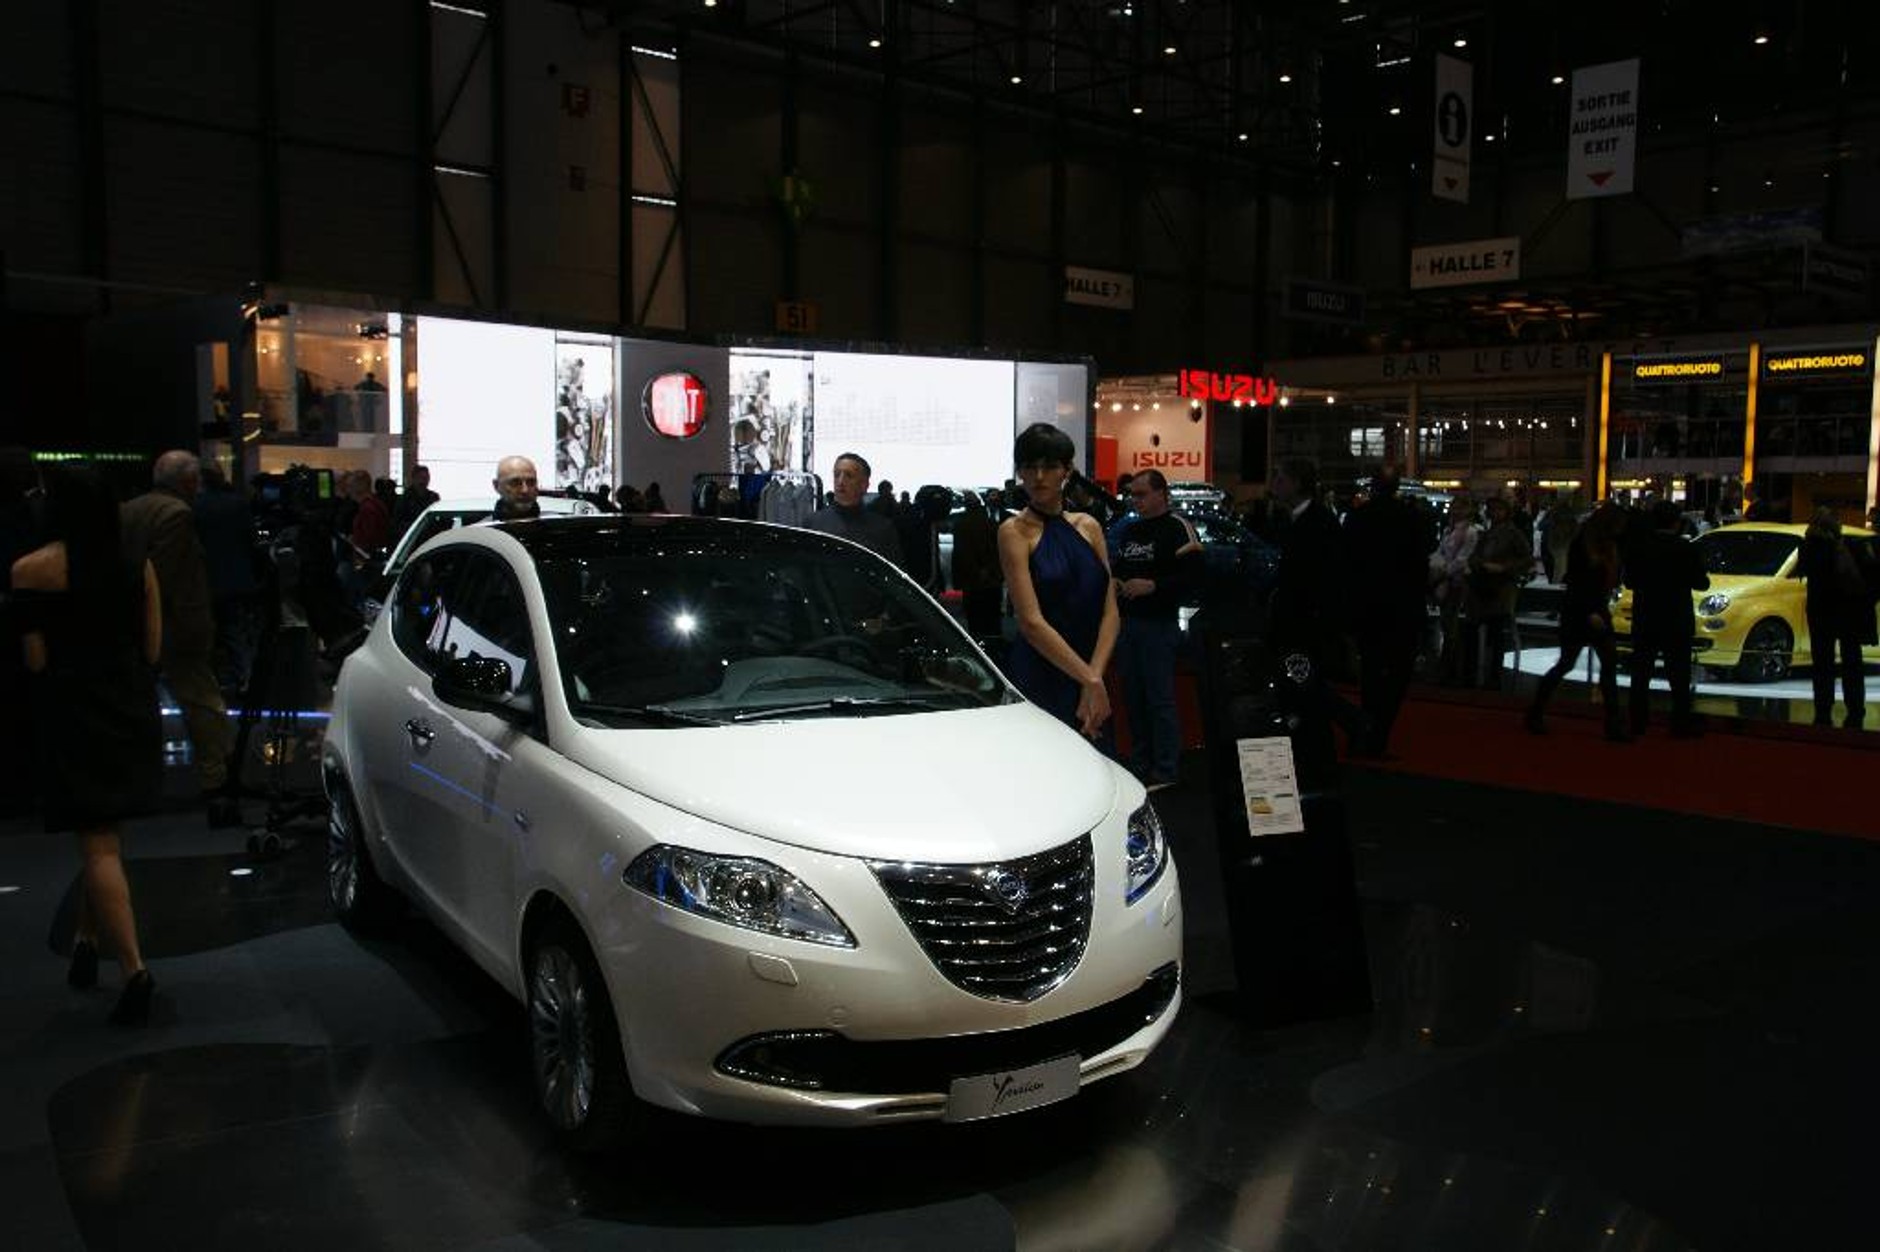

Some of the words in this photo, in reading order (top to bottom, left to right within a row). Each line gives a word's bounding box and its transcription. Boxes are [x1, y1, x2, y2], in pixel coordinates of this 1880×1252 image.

[1577, 91, 1631, 112] SORTIE
[1572, 113, 1636, 135] AUSGANG
[1584, 136, 1619, 154] EXIT
[1429, 252, 1495, 275] HALLE
[1502, 250, 1514, 267] 7
[1064, 279, 1109, 297] HALLE
[1382, 352, 1441, 377] BAR
[1180, 369, 1275, 406] ISUZU
[1133, 451, 1201, 468] ISUZU
